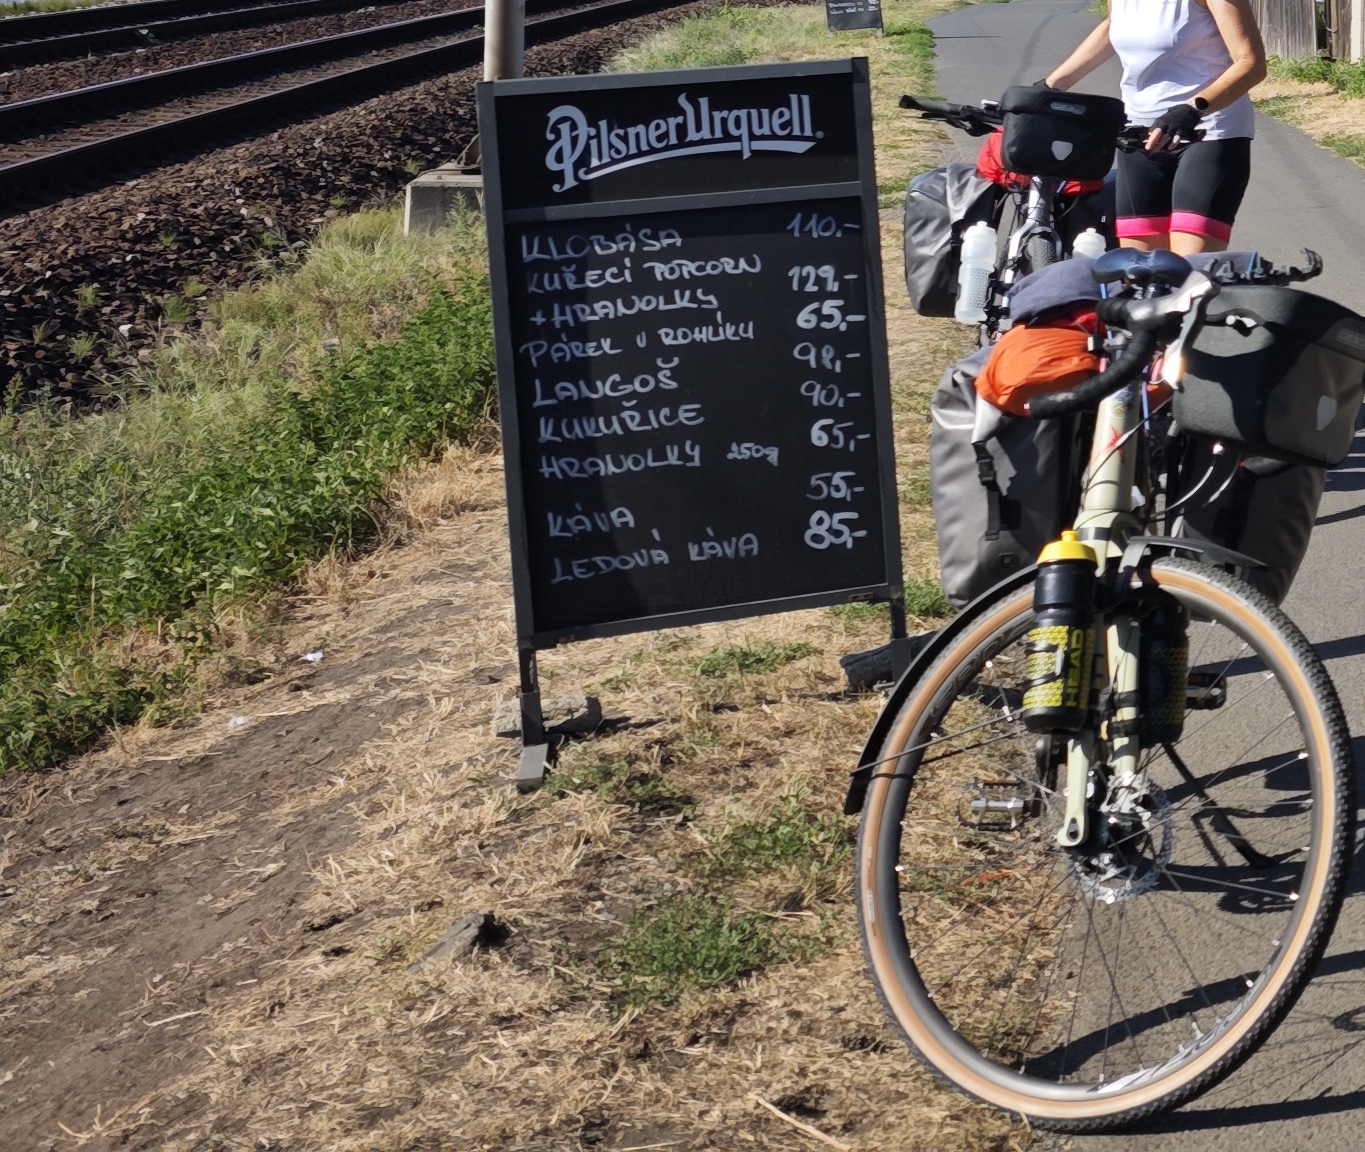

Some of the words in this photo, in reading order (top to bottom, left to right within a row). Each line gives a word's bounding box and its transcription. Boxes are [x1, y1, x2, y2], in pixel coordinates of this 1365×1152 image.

[545, 105, 686, 192] Pilsner
[677, 92, 814, 159] Urquell
[521, 224, 682, 262] KLOBÁSA
[527, 257, 633, 294] KUŘECÍ
[643, 254, 761, 282] POPCORN
[519, 332, 622, 368] PÁREK
[657, 311, 755, 346] ROHLÍKU
[533, 357, 680, 408] LANGOŠ
[537, 399, 706, 443] KUKUŘICE
[540, 440, 702, 479] HRANOLKY
[547, 503, 636, 538] KÁVA
[551, 528, 670, 584] LEDOVÁ
[687, 526, 760, 563] KÁVA
[1065, 629, 1084, 707] HEAD
